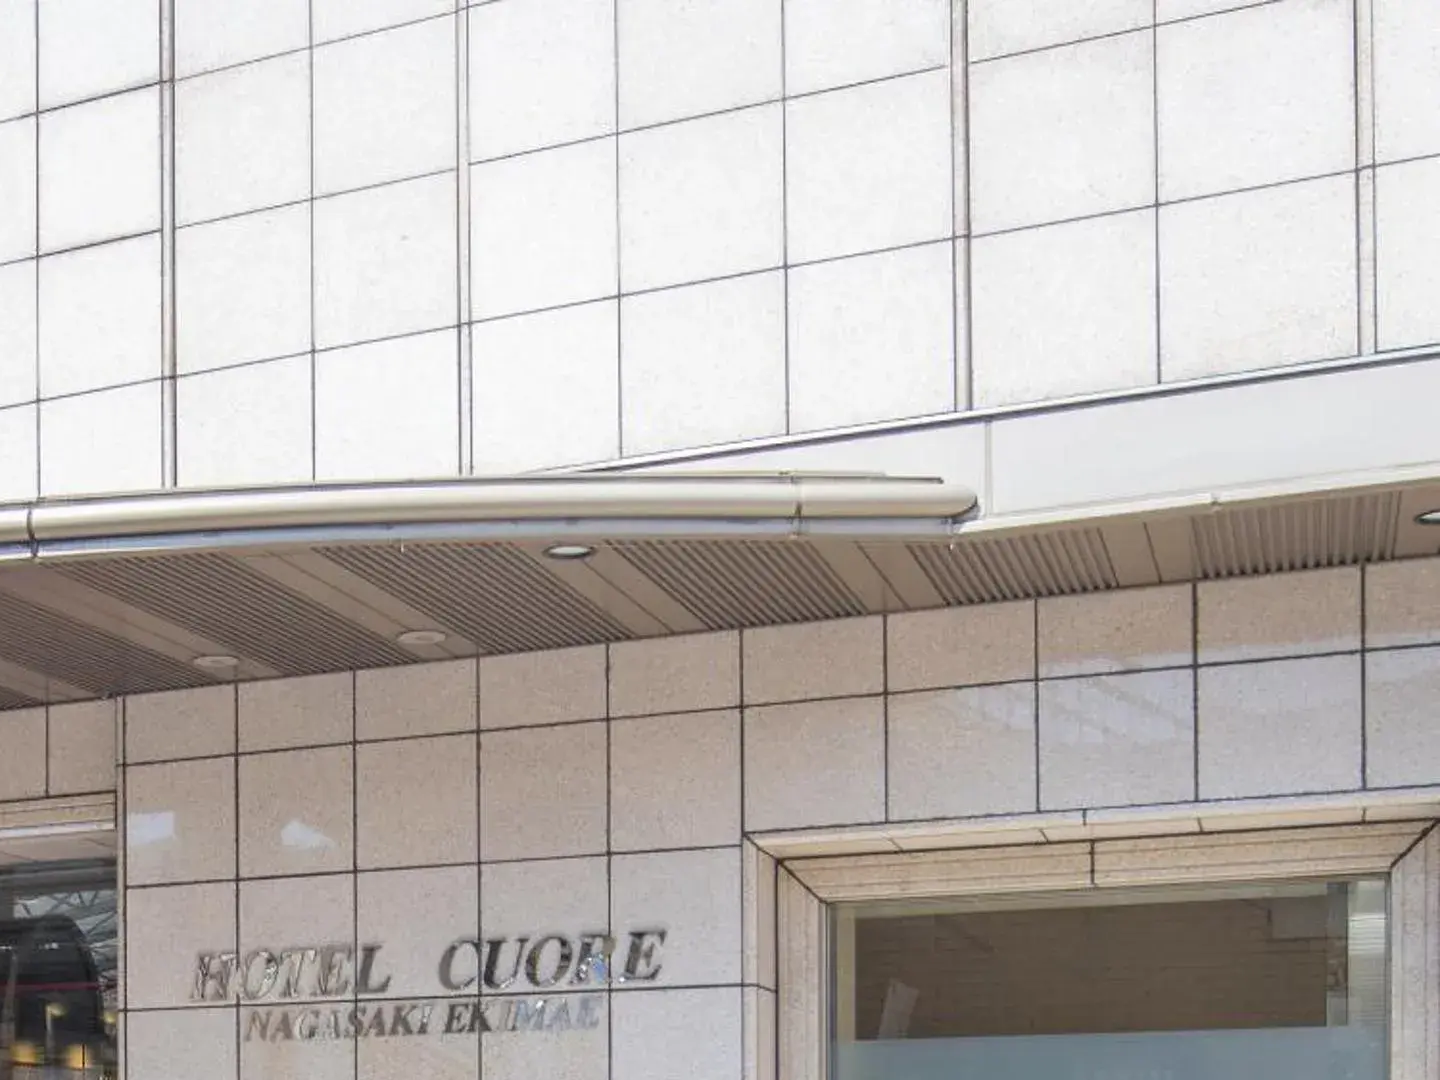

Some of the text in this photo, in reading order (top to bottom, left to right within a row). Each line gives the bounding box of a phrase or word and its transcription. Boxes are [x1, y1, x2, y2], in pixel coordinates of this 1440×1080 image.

[190, 929, 667, 1000] HOTEL CUORE
[243, 994, 602, 1043] NAGASAKI EKIMAE
